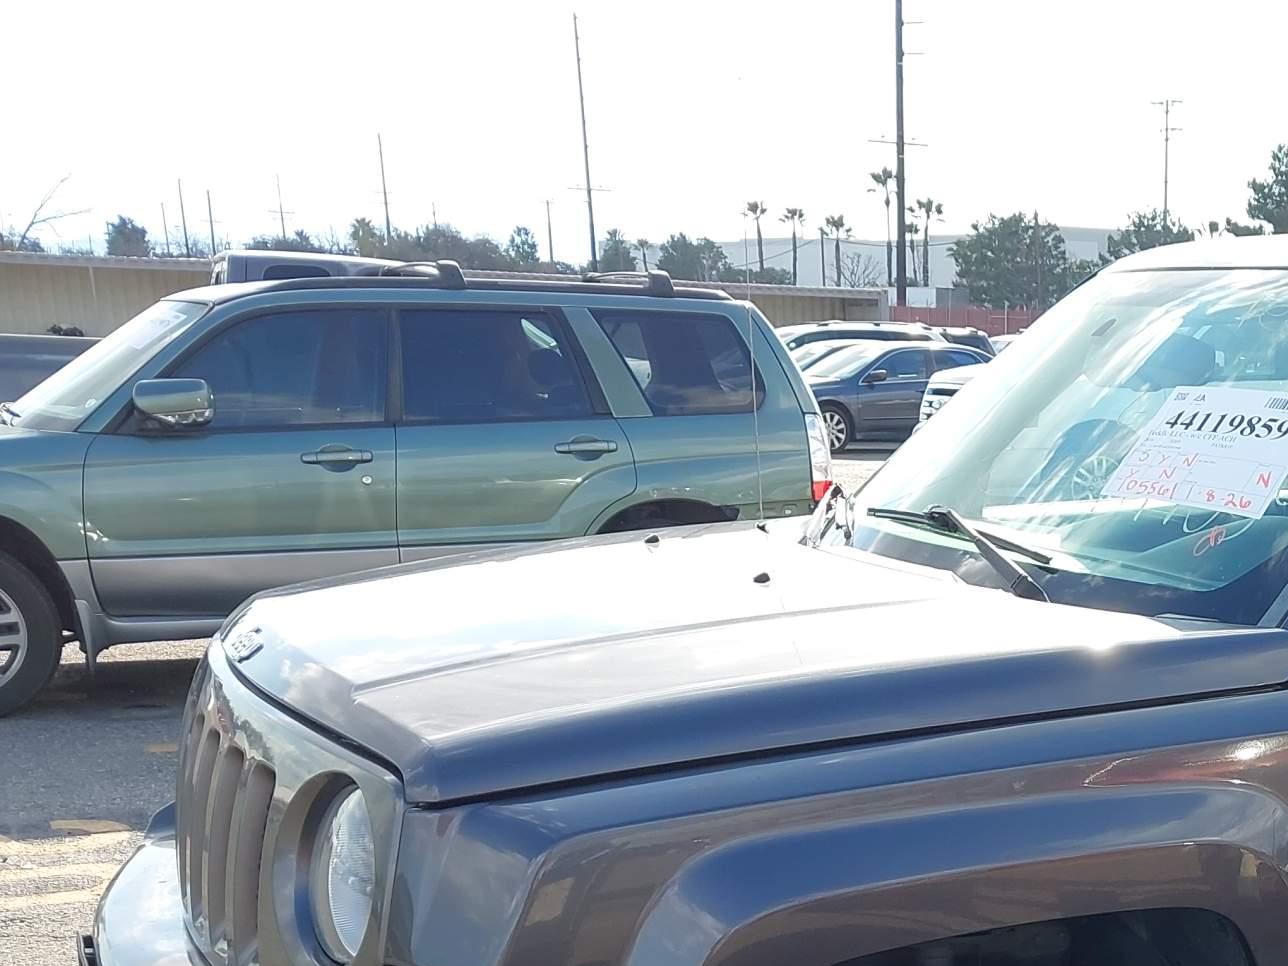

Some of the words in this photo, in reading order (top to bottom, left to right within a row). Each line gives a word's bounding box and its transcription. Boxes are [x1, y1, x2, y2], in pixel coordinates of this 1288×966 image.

[1182, 453, 1199, 467] N
[1158, 466, 1177, 480] N
[1256, 471, 1273, 488] N
